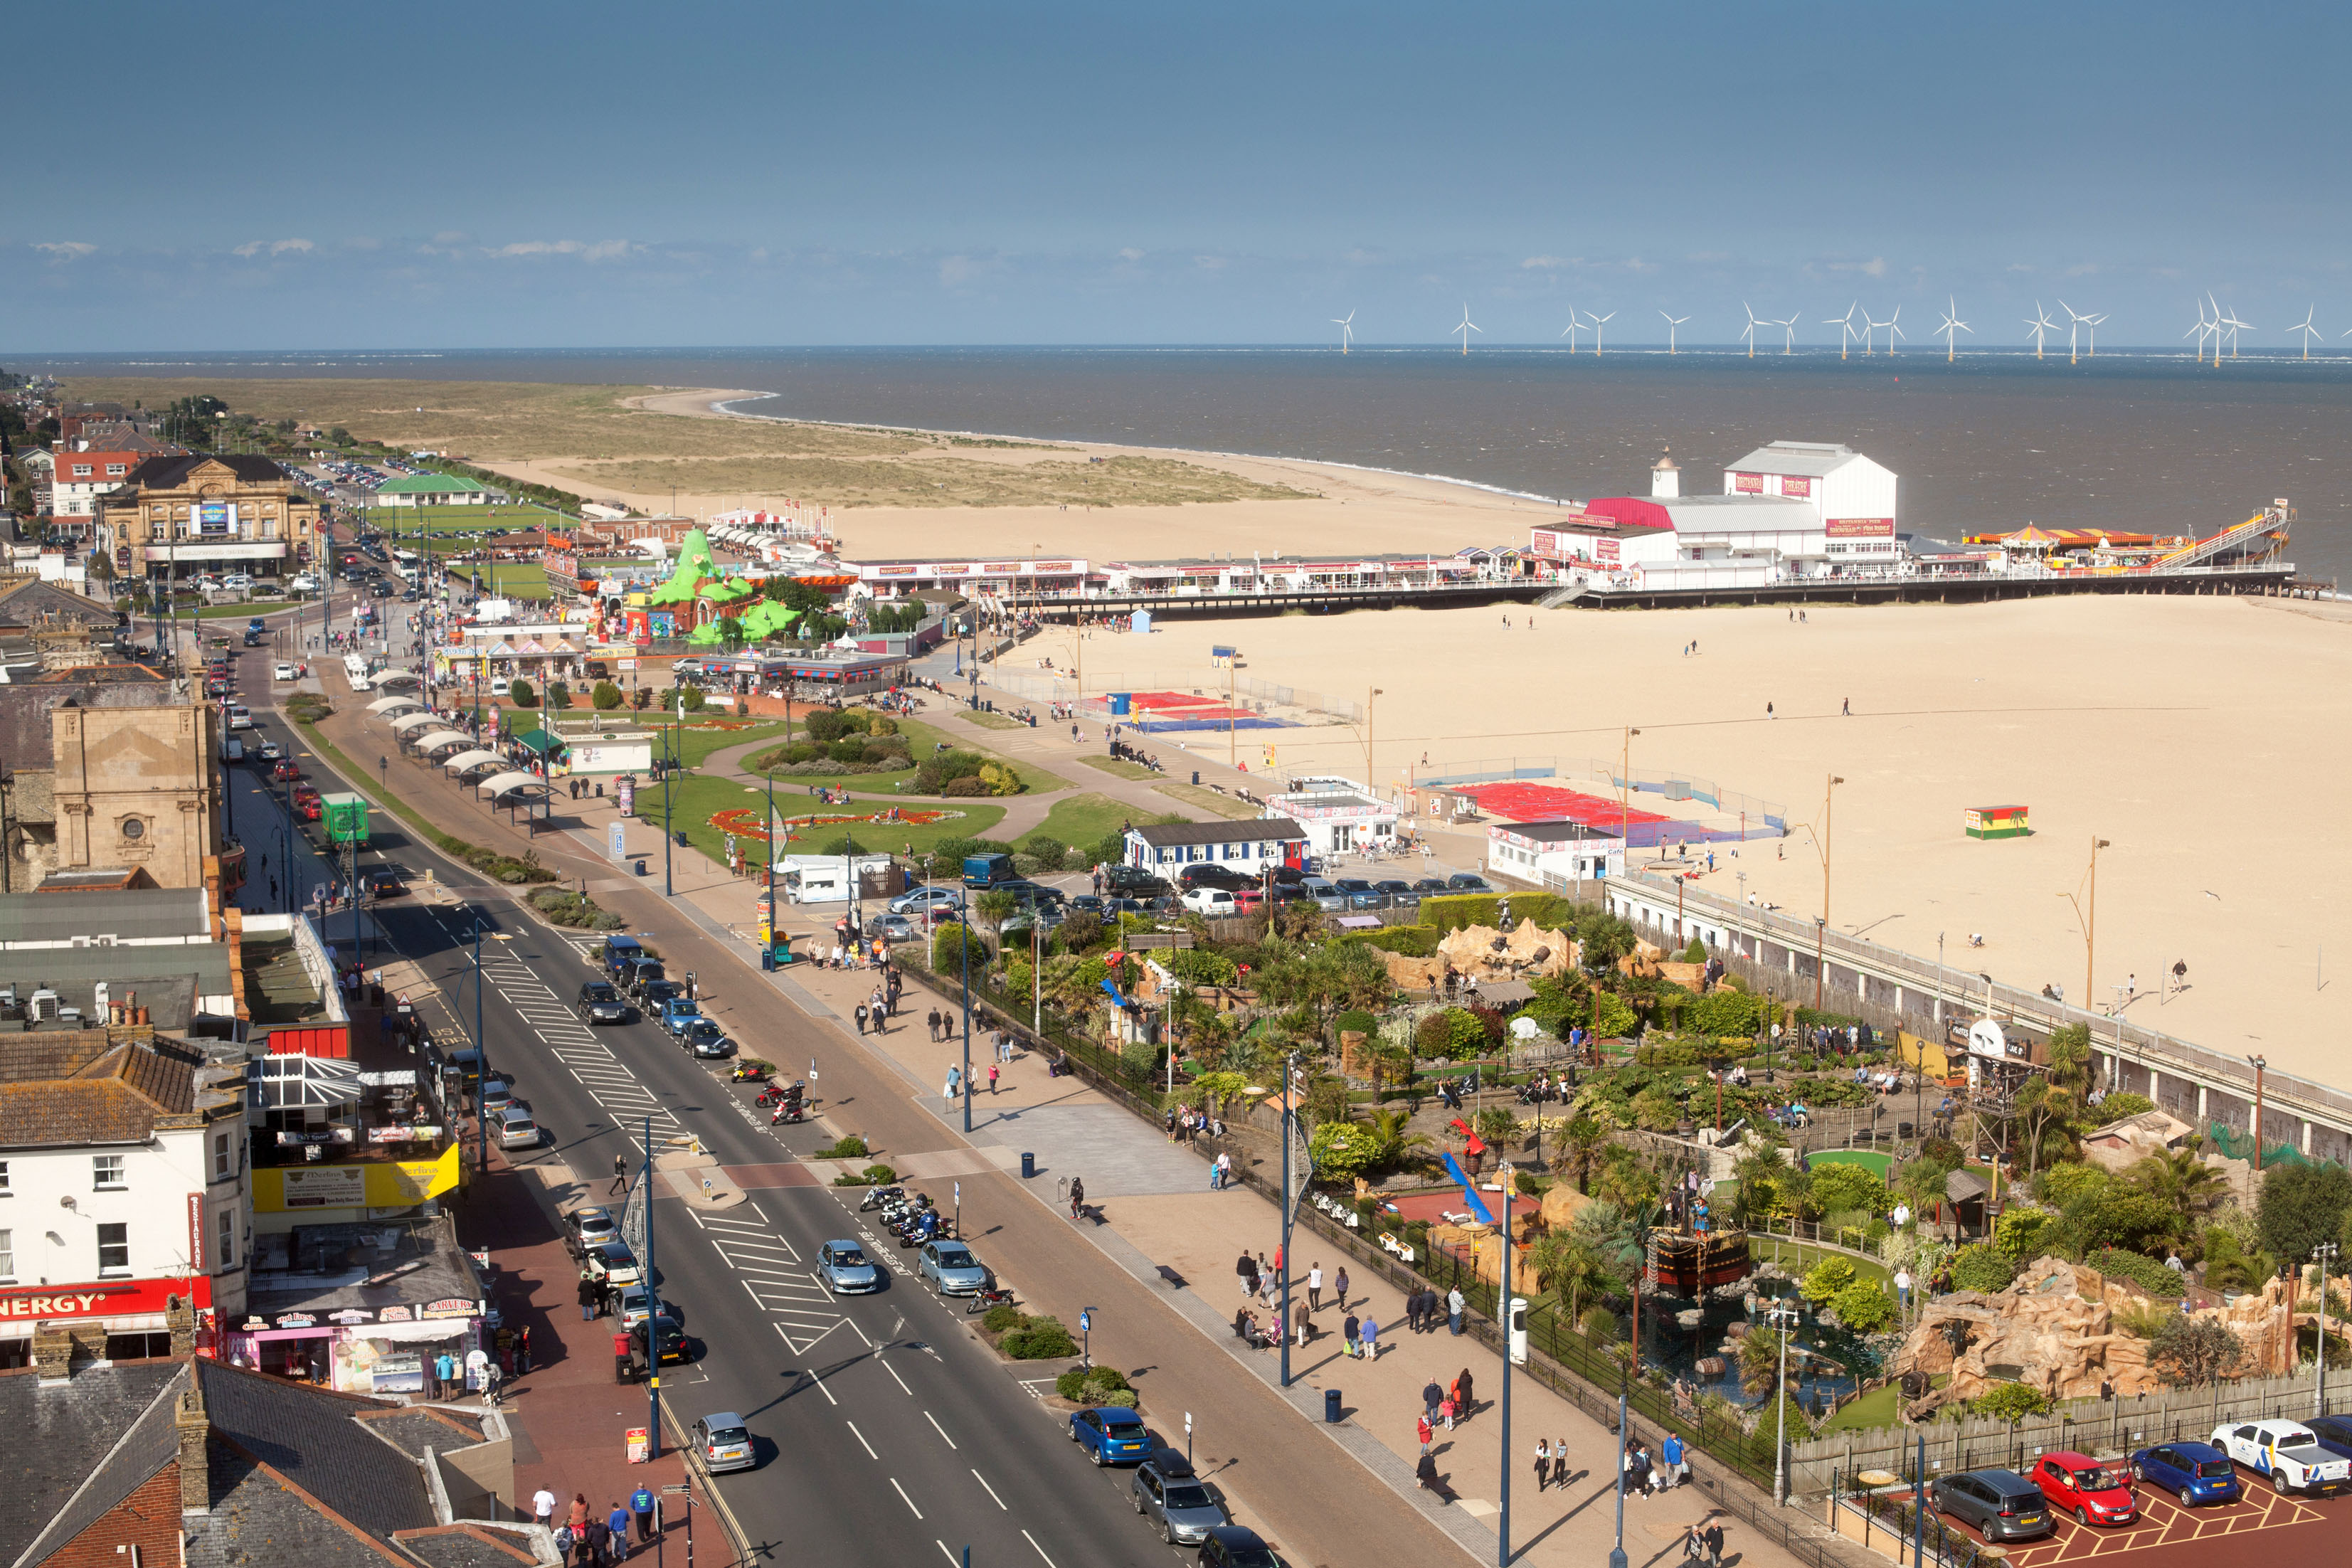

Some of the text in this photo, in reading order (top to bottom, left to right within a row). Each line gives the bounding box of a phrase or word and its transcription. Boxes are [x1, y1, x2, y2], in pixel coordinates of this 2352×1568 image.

[1737, 476, 1762, 489] BRITANNIA
[1784, 480, 1807, 492] THEATRE
[592, 649, 614, 657] Beach
[1509, 834, 1521, 843] Cafe
[1952, 1026, 1969, 1037] PIRATES
[190, 1197, 201, 1268] RESTAURANT
[858, 1231, 874, 1241] SOLO
[867, 1241, 899, 1266] MOTORCYCLES
[892, 1266, 911, 1276] ONLY
[428, 1299, 474, 1311] CARVERY
[277, 1312, 317, 1324] Hot Fresh
[388, 1313, 412, 1321] Slush
[423, 1309, 479, 1319] Baguettes
[249, 1315, 263, 1324] Ice
[341, 1316, 362, 1325] Rock
